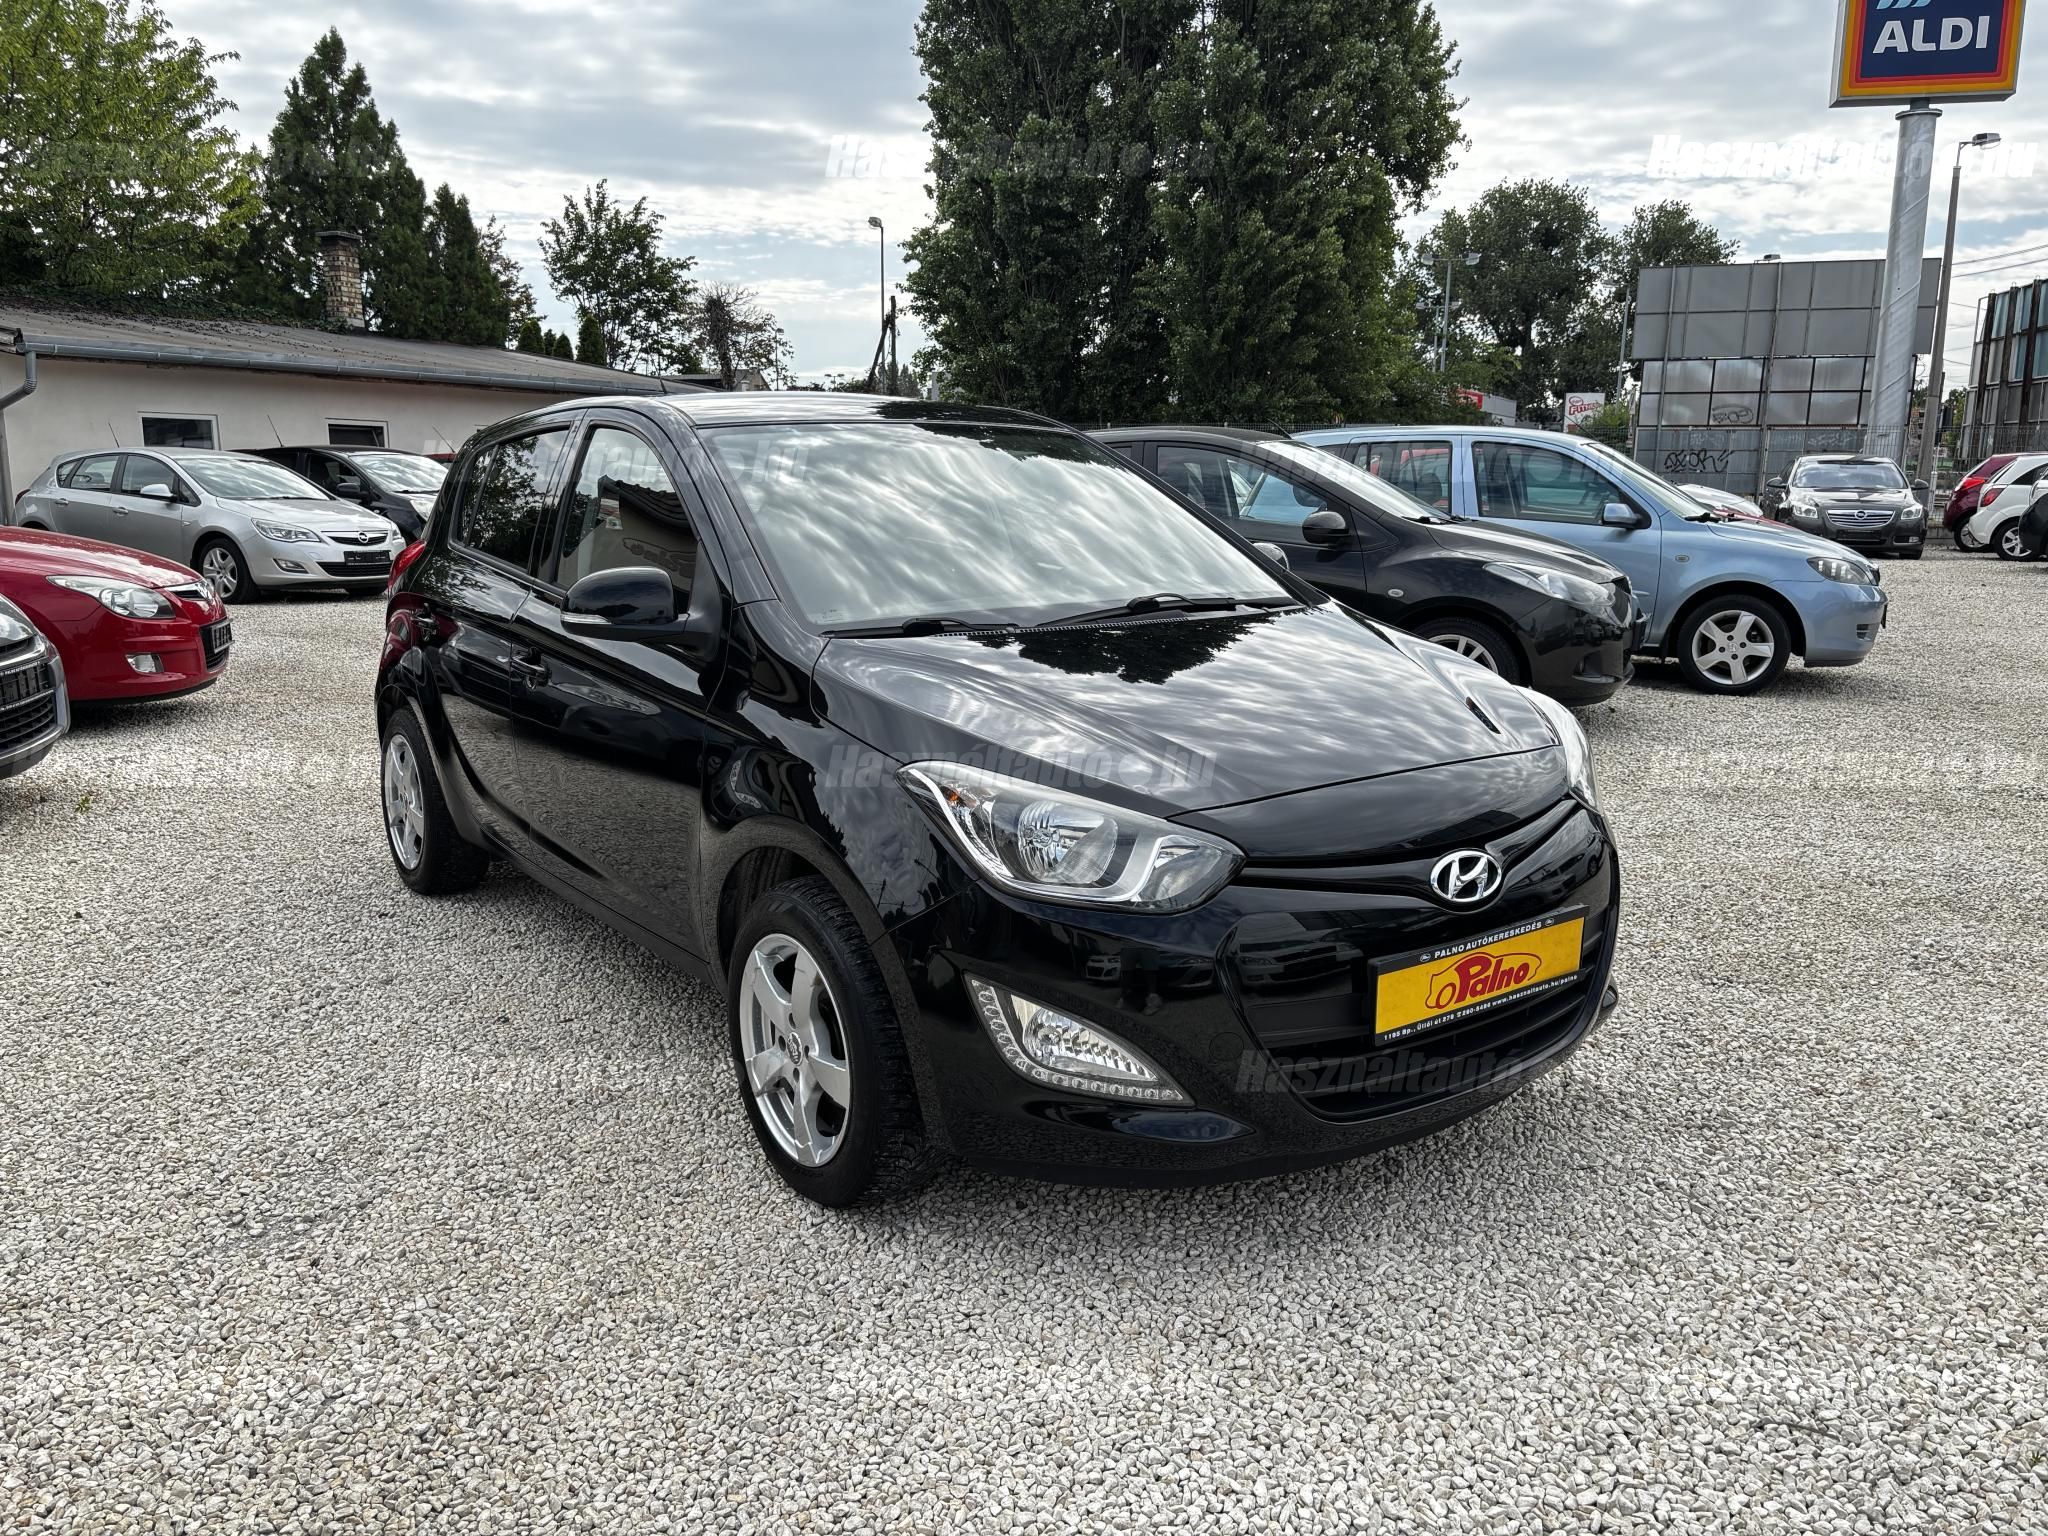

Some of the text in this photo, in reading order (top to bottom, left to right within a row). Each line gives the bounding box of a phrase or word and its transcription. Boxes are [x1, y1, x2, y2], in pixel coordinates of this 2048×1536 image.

[1872, 15, 1990, 54] ALDI
[1434, 920, 1542, 959] PALNO AUTÓKERESKEDÉS
[1453, 955, 1530, 1004] Palno
